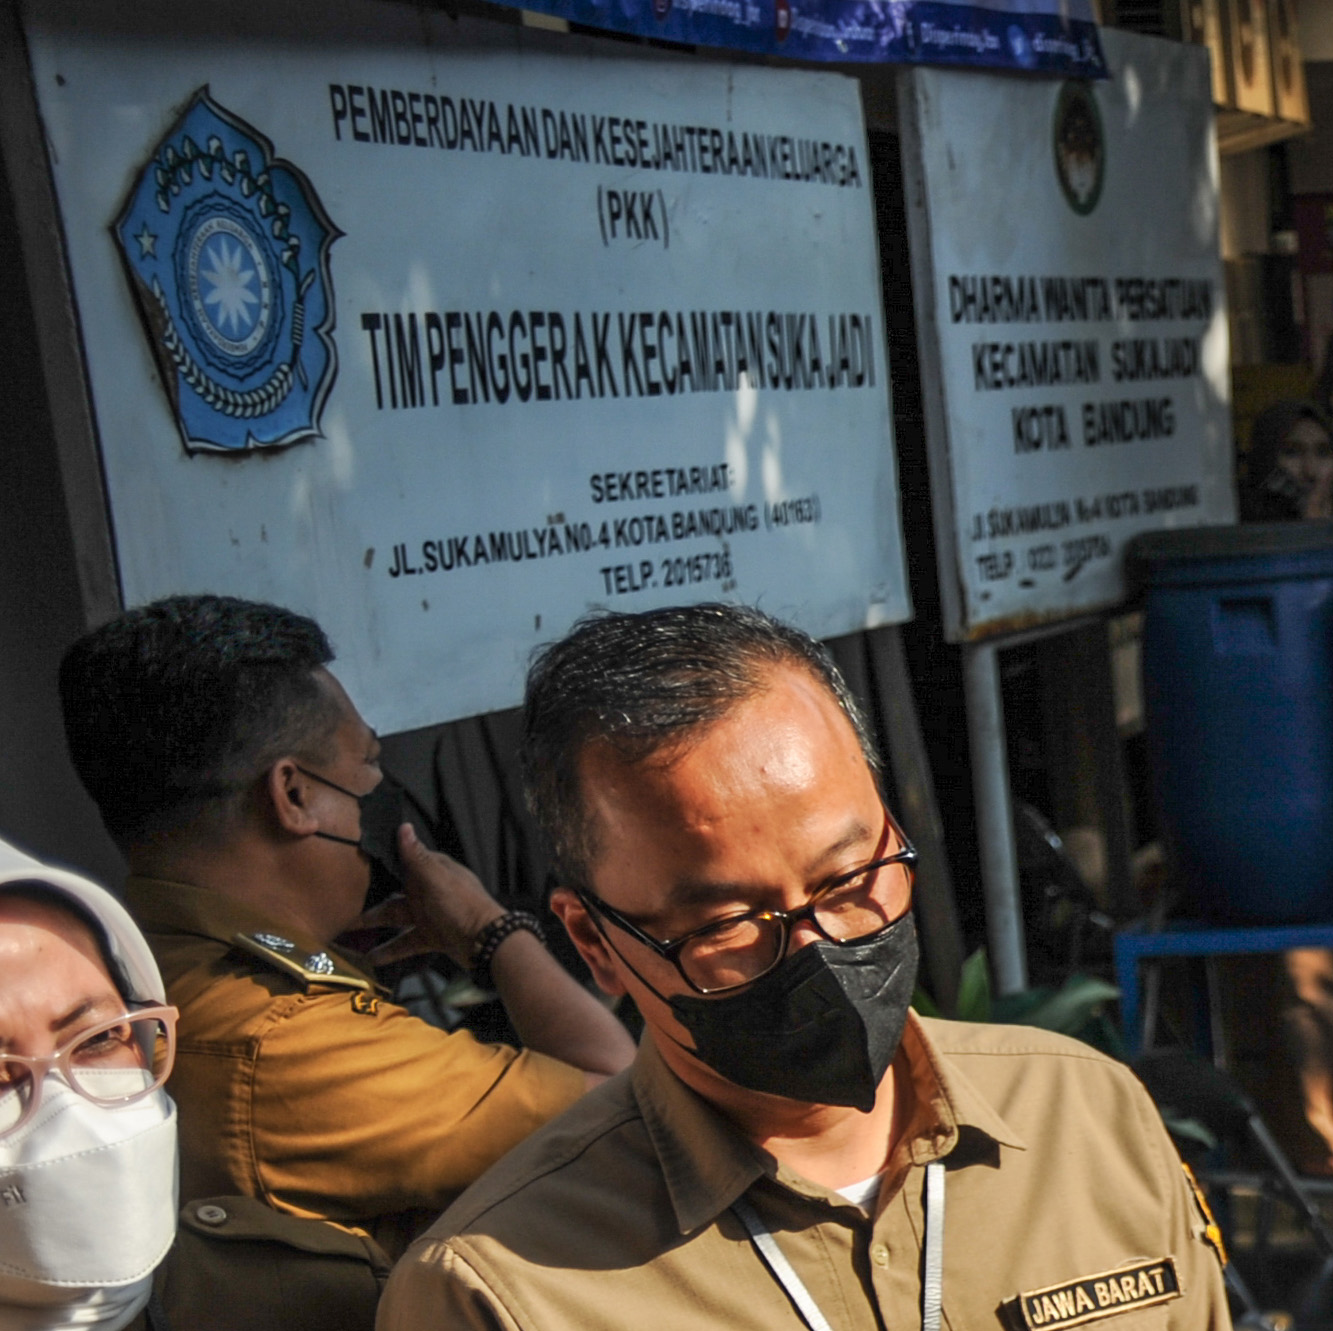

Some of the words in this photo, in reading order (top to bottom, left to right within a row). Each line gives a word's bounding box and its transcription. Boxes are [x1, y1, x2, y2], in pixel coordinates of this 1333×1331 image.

[329, 84, 540, 158] PEMBERDAYAAN
[541, 107, 590, 163] DAN
[592, 114, 767, 180] KESEJAHTERAAN
[767, 134, 862, 188] KELUARGA
[597, 184, 669, 249] (PKK)
[948, 274, 1041, 325] DHARMA
[1041, 276, 1113, 322] WANITA
[361, 312, 425, 410] TIM
[425, 310, 619, 405] PENGGERAK
[618, 310, 767, 398] KECAMATAN
[972, 339, 1099, 392] KECAMATAN
[1012, 402, 1073, 455] KOTA
[1082, 397, 1177, 447] BANDUNG
[613, 515, 671, 548] KOTA
[671, 503, 759, 541] BANDUNG
[600, 560, 658, 596] TELP.
[1032, 1286, 1096, 1325] JAWA
[1094, 1267, 1165, 1308] BARAT
